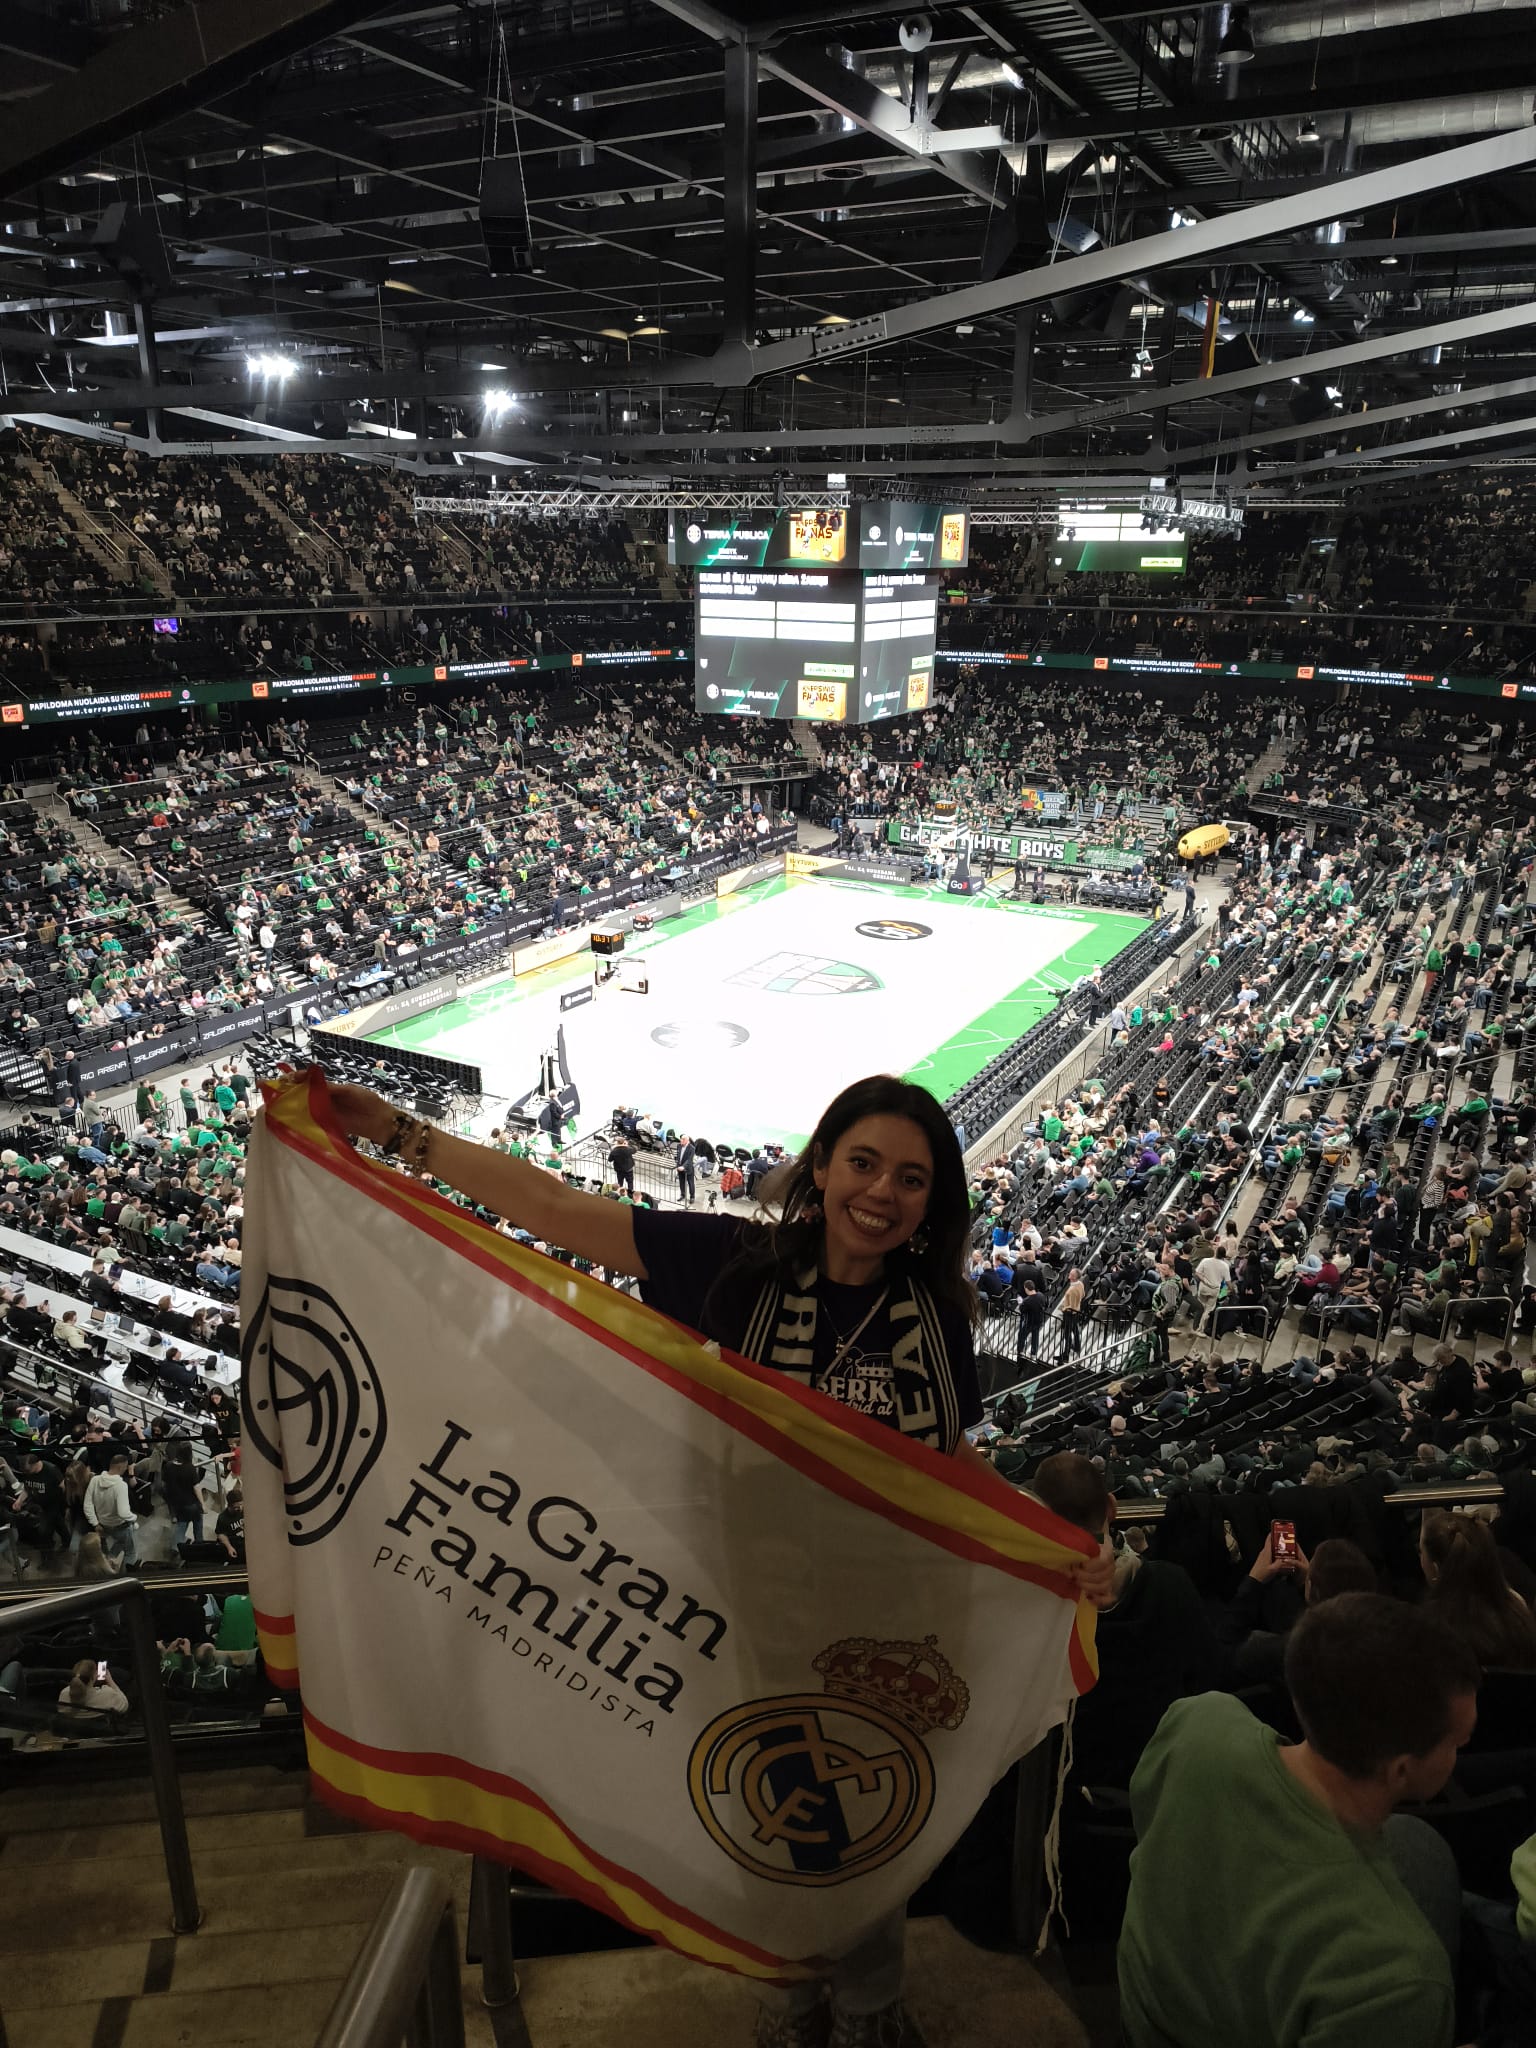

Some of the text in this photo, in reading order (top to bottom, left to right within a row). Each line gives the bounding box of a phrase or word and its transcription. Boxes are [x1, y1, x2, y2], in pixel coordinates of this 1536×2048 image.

[29, 699, 74, 711] PAPILDOMA
[73, 696, 111, 707] NUOLAIDA
[110, 695, 120, 704] SU
[120, 693, 140, 703] KODU
[56, 701, 151, 718] www.terrapublica.lt
[1019, 839, 1065, 860] BOYS
[237, 1015, 262, 1030] ARENA
[97, 1060, 127, 1076] ARENA
[384, 1478, 685, 1714] Familia
[373, 1546, 657, 1738] PEÑA MADRIDISTA
